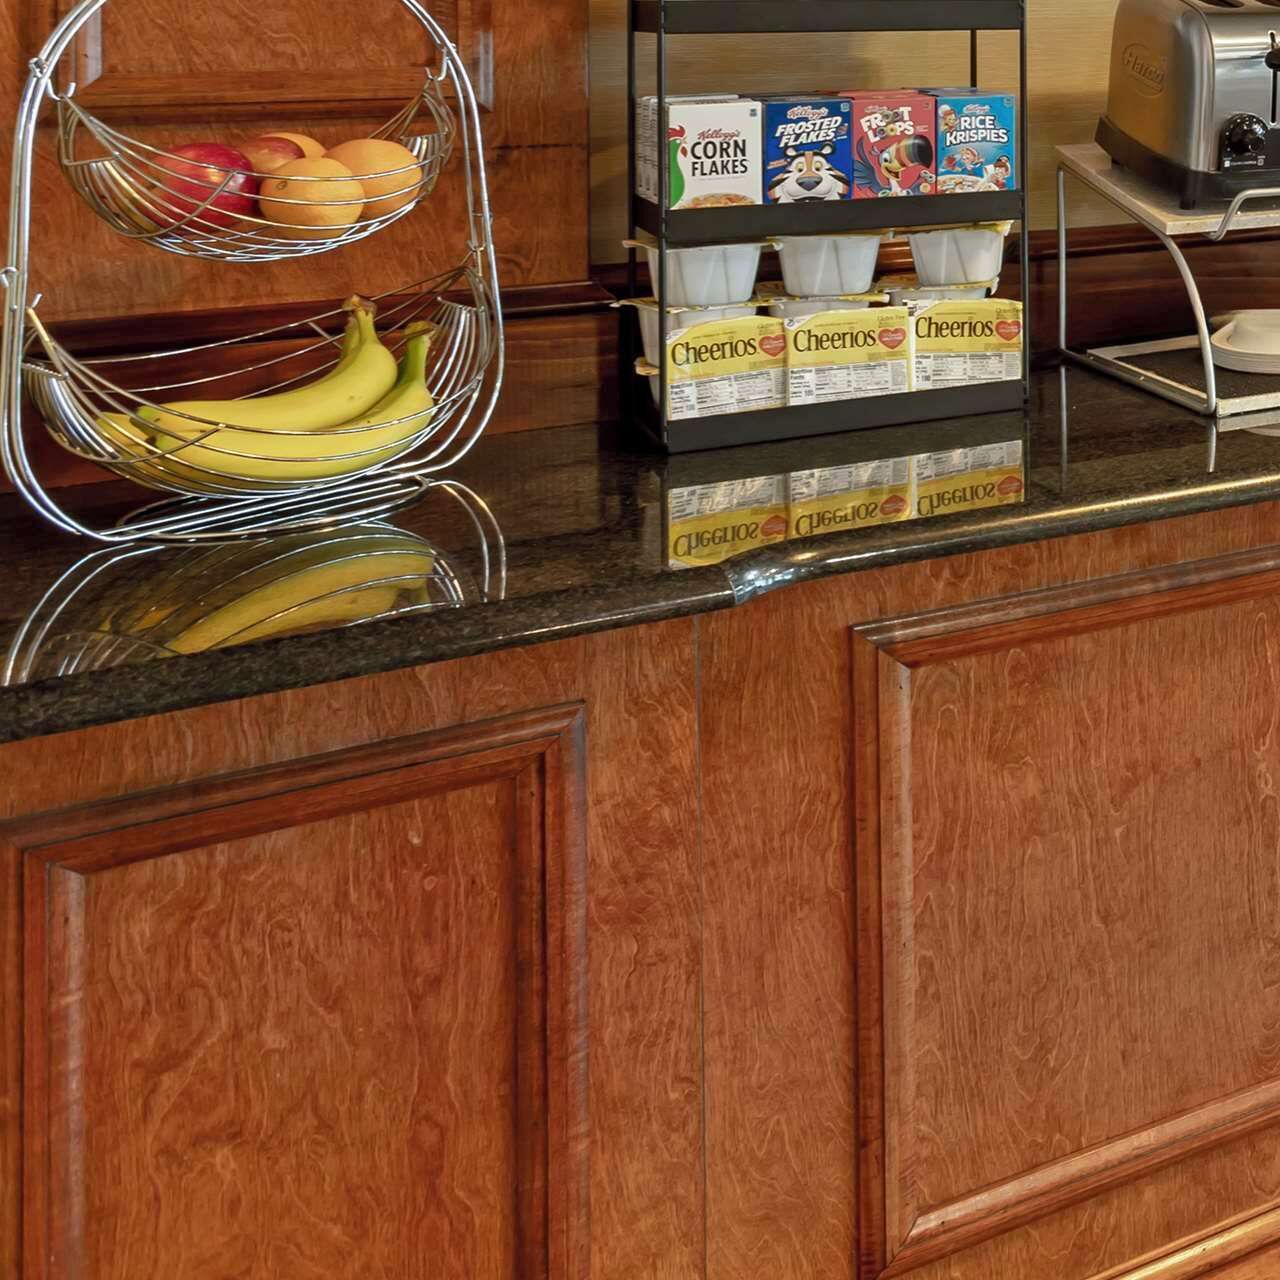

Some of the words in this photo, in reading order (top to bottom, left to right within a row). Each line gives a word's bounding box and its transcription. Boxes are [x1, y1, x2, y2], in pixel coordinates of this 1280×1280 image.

[775, 116, 843, 138] FROSTED
[867, 121, 915, 143] LOOPS
[960, 115, 996, 130] RICE
[697, 129, 740, 143] Kellogg's
[779, 128, 837, 148] FLAKES
[946, 129, 1009, 147] KRISPIES
[690, 139, 747, 160] CORN
[691, 159, 748, 177] FLAKES
[915, 316, 995, 339] Cheerios
[793, 329, 877, 353] Cheerios
[671, 337, 758, 367] Cheerios
